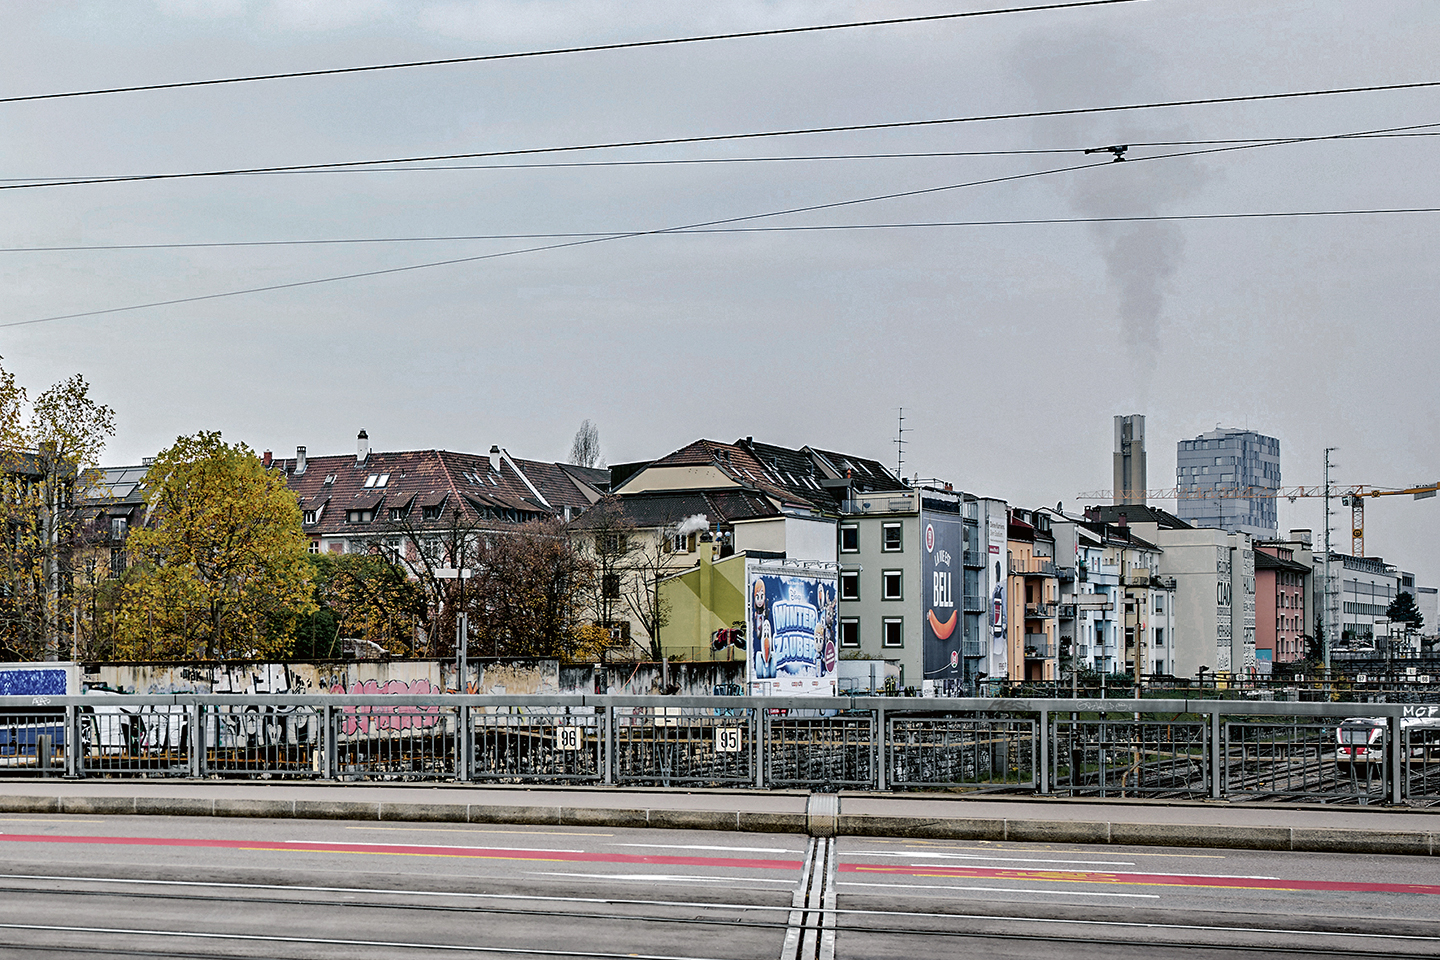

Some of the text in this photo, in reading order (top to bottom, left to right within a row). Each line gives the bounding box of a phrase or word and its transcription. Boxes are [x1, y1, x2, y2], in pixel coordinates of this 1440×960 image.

[933, 571, 953, 607] BELL
[1217, 581, 1230, 606] CIAO
[775, 603, 816, 633] WINTER
[773, 635, 817, 661] ZAUBER
[561, 731, 576, 747] 96
[719, 732, 736, 749] 95
